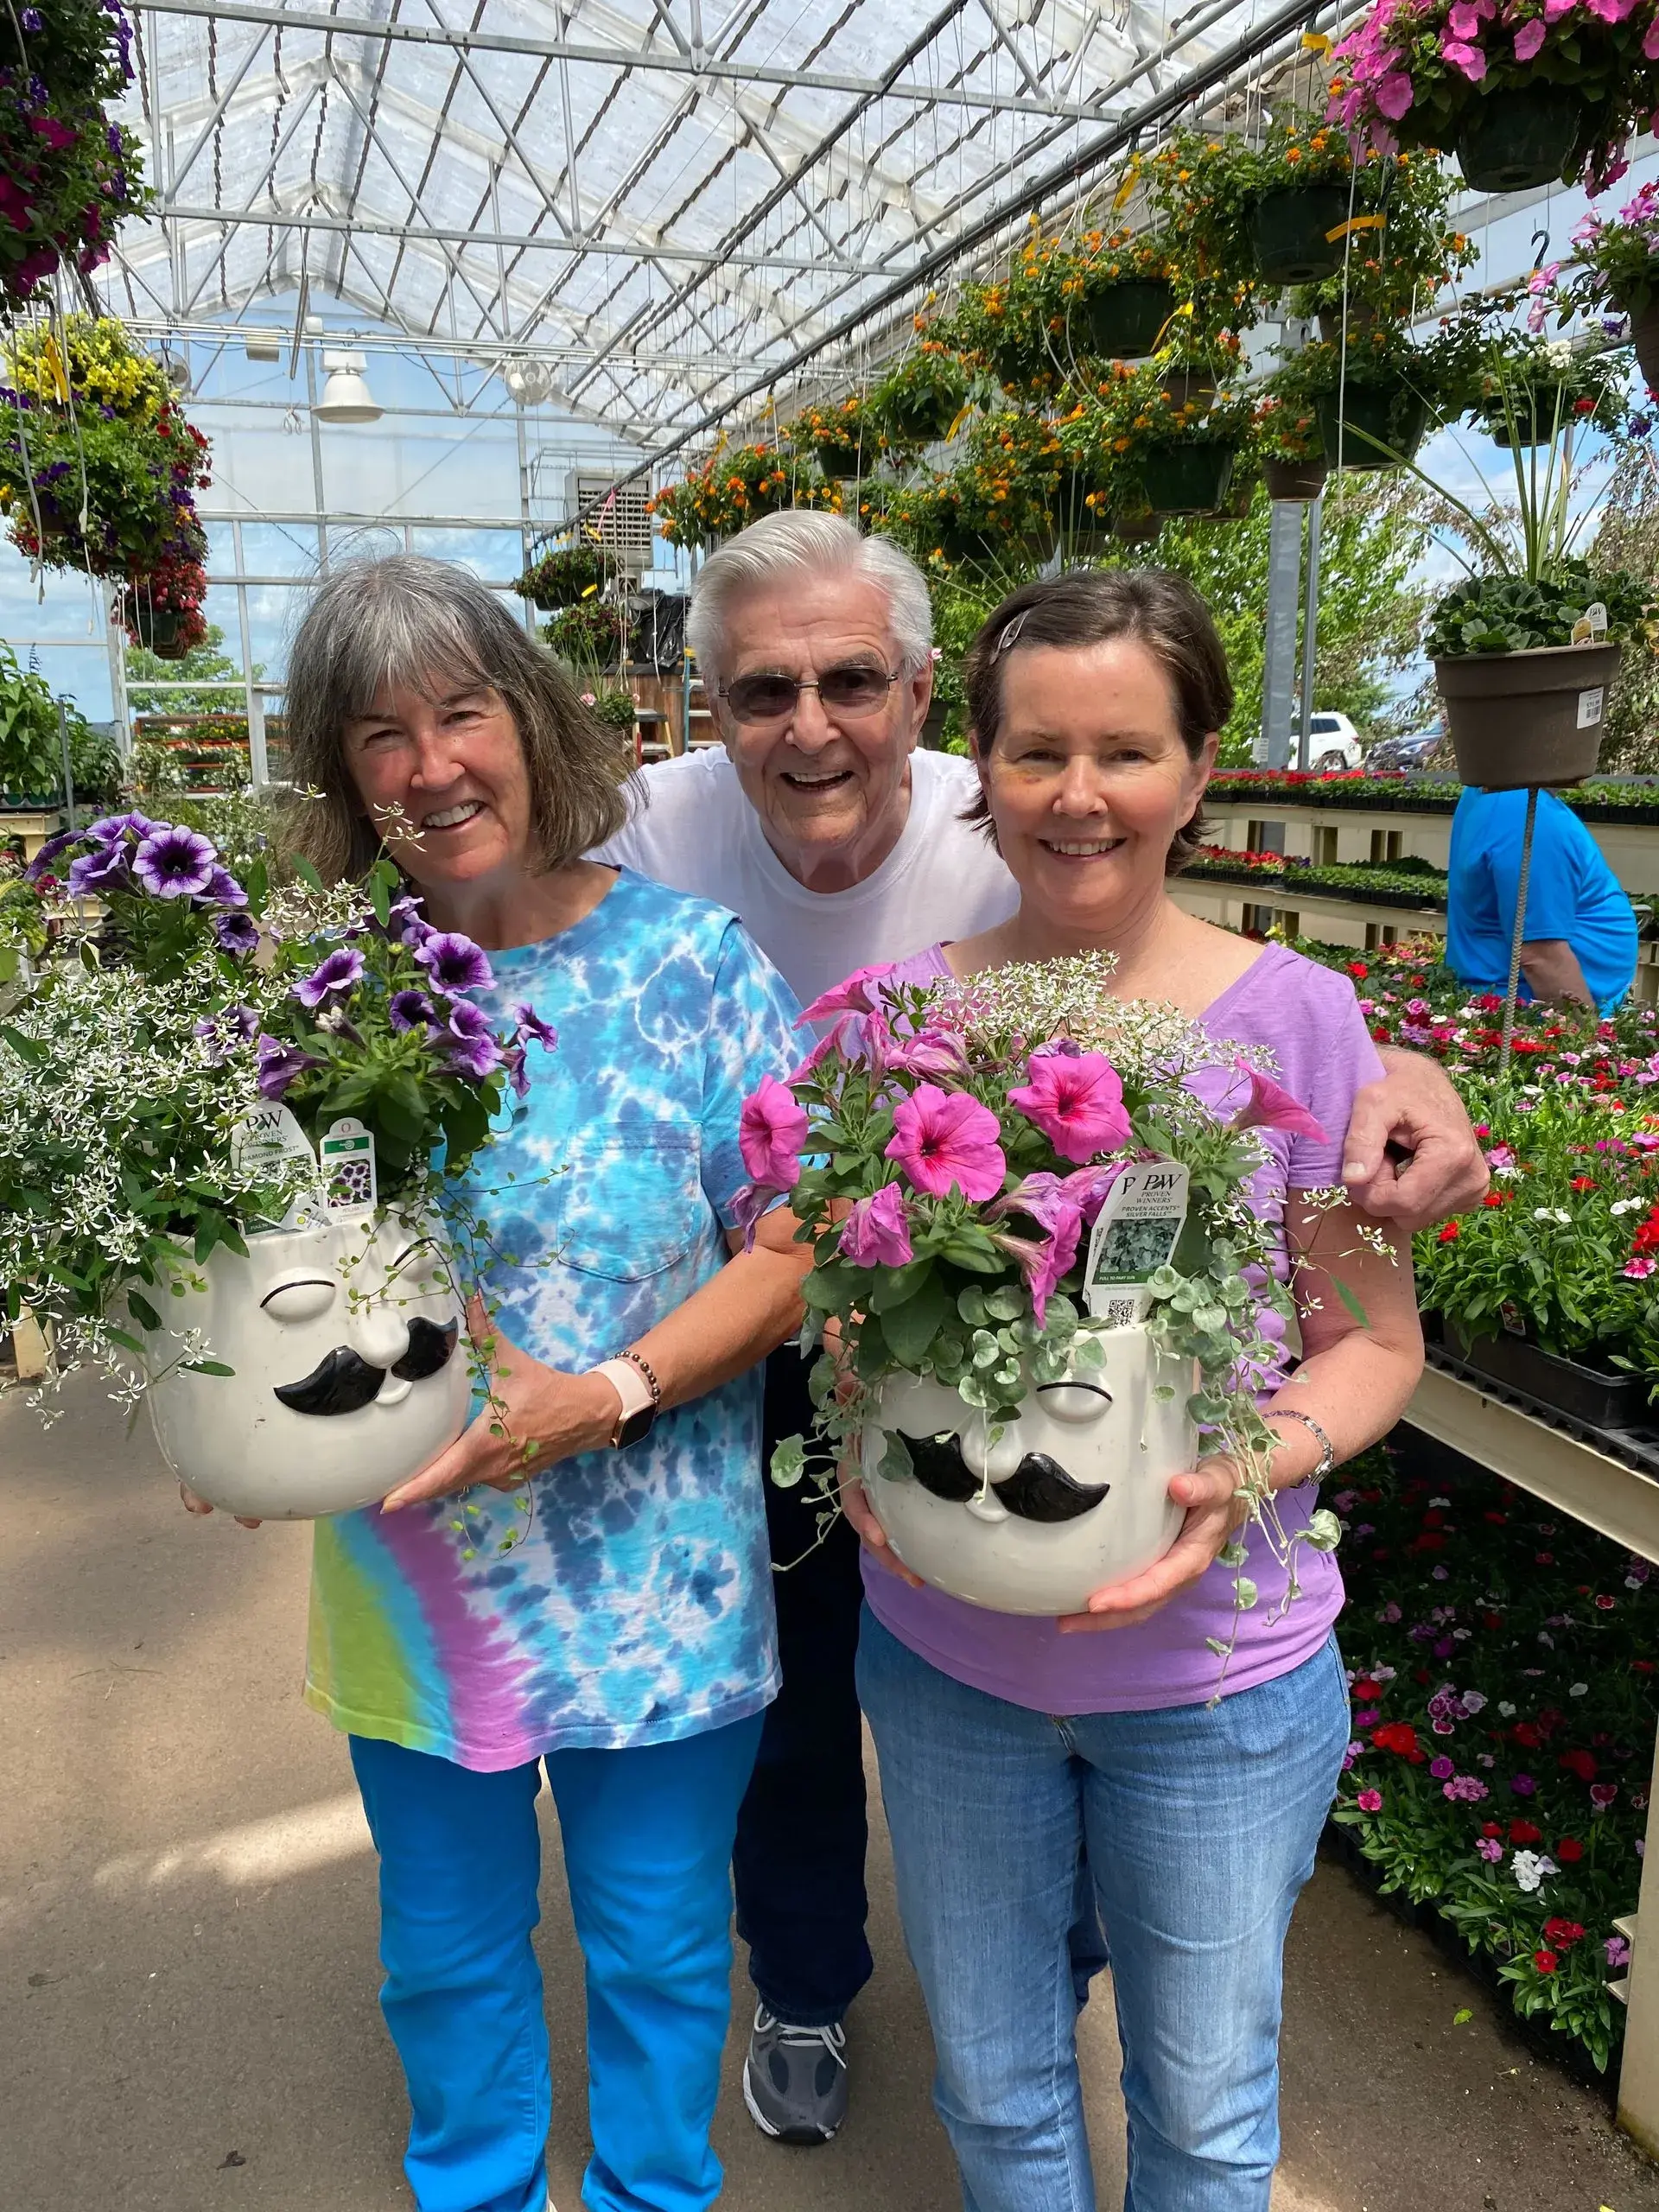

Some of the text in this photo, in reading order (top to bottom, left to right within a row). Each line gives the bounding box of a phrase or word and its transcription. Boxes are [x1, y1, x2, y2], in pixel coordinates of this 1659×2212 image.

[245, 1109, 283, 1130] PW
[240, 1150, 274, 1163] DIAMOND
[1141, 1173, 1184, 1191] PW
